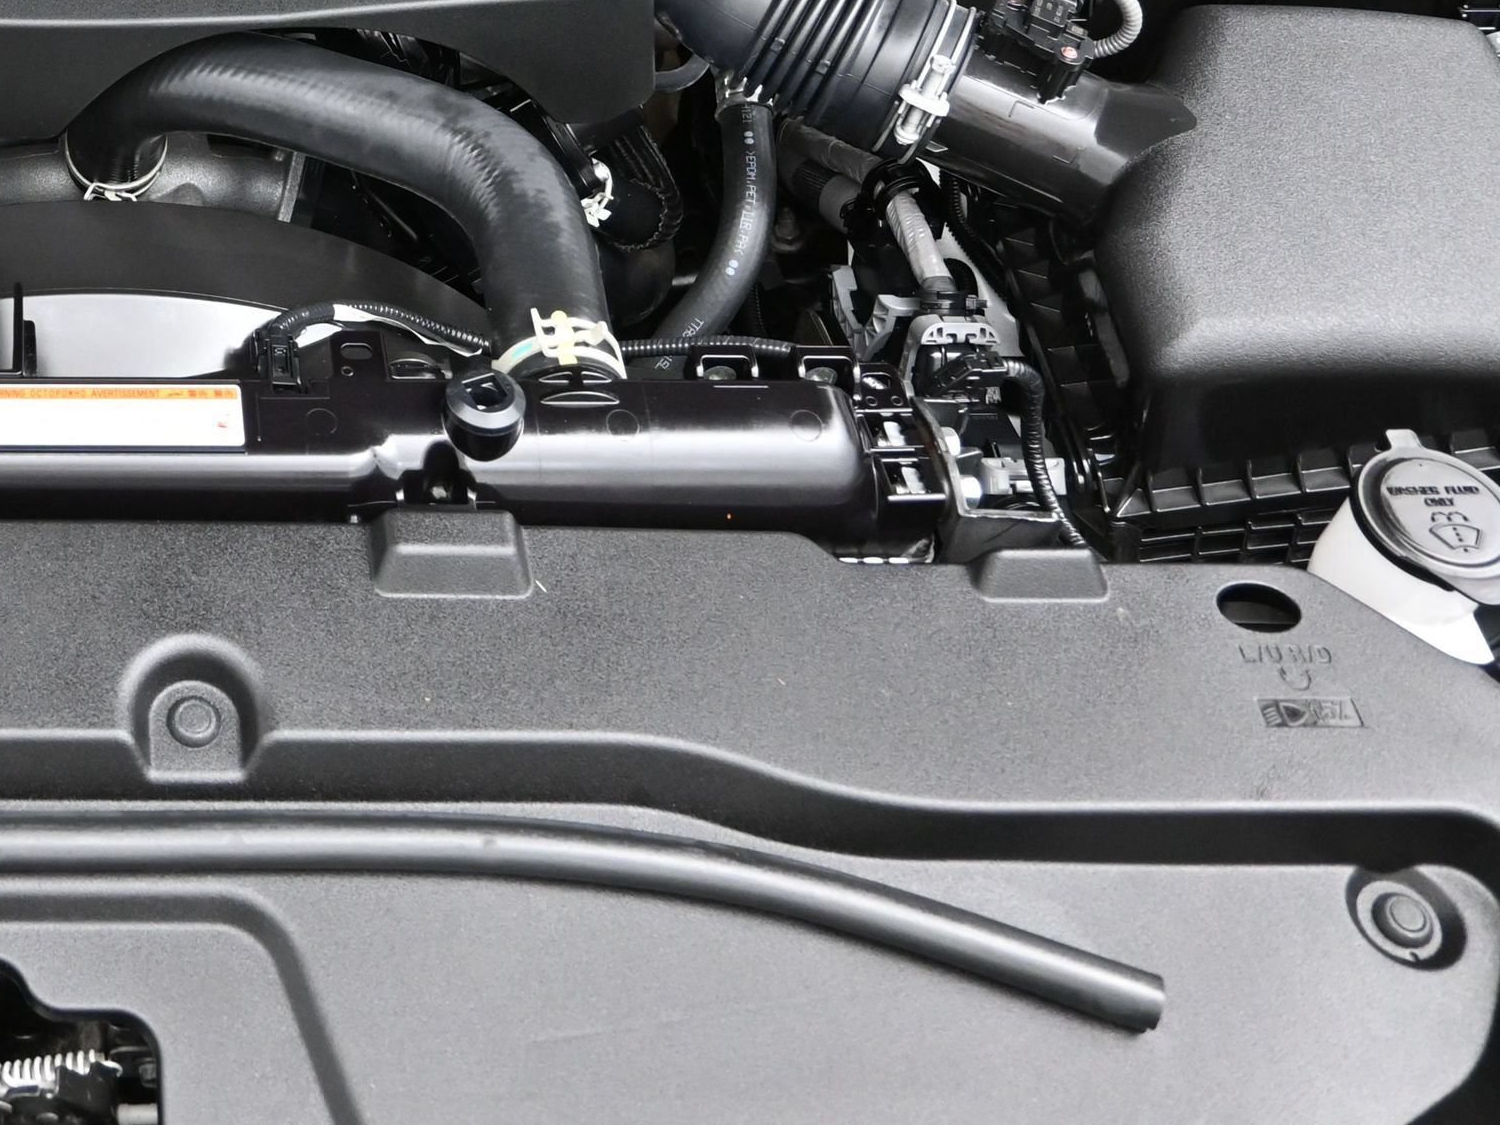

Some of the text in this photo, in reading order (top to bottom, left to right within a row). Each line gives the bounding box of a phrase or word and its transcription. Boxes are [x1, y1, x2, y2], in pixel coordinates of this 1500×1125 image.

[91, 389, 160, 397] AVERTISSEMENT
[1386, 485, 1480, 495] WASHER FLUID
[1423, 497, 1455, 507] ONLY
